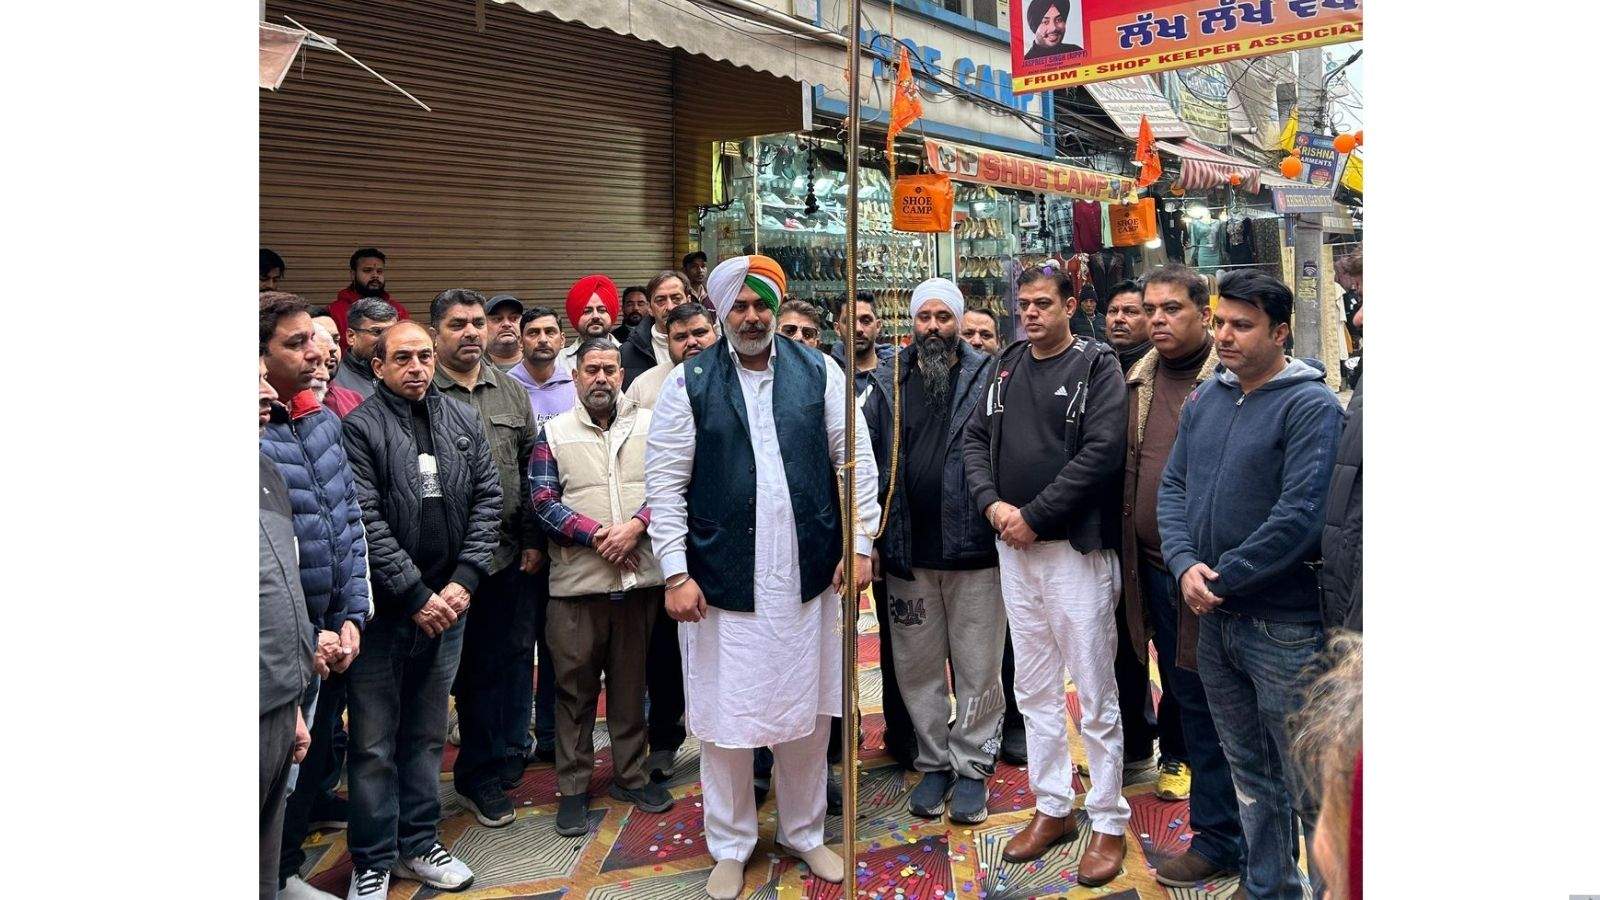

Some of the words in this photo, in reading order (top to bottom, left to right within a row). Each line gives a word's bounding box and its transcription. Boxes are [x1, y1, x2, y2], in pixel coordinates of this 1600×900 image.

[1117, 13, 1188, 49] ਲੱਖ
[1023, 69, 1078, 86] FROM
[1096, 58, 1151, 73] SHOP
[1158, 43, 1241, 64] KEEPER
[1298, 145, 1335, 160] RISHNA
[1300, 156, 1332, 167] ARMENTS
[984, 153, 1049, 189] SHOE
[1053, 168, 1109, 197] CAMP
[902, 196, 932, 205] SHOE
[902, 205, 933, 214] CAMP
[1116, 218, 1139, 227] SHOE
